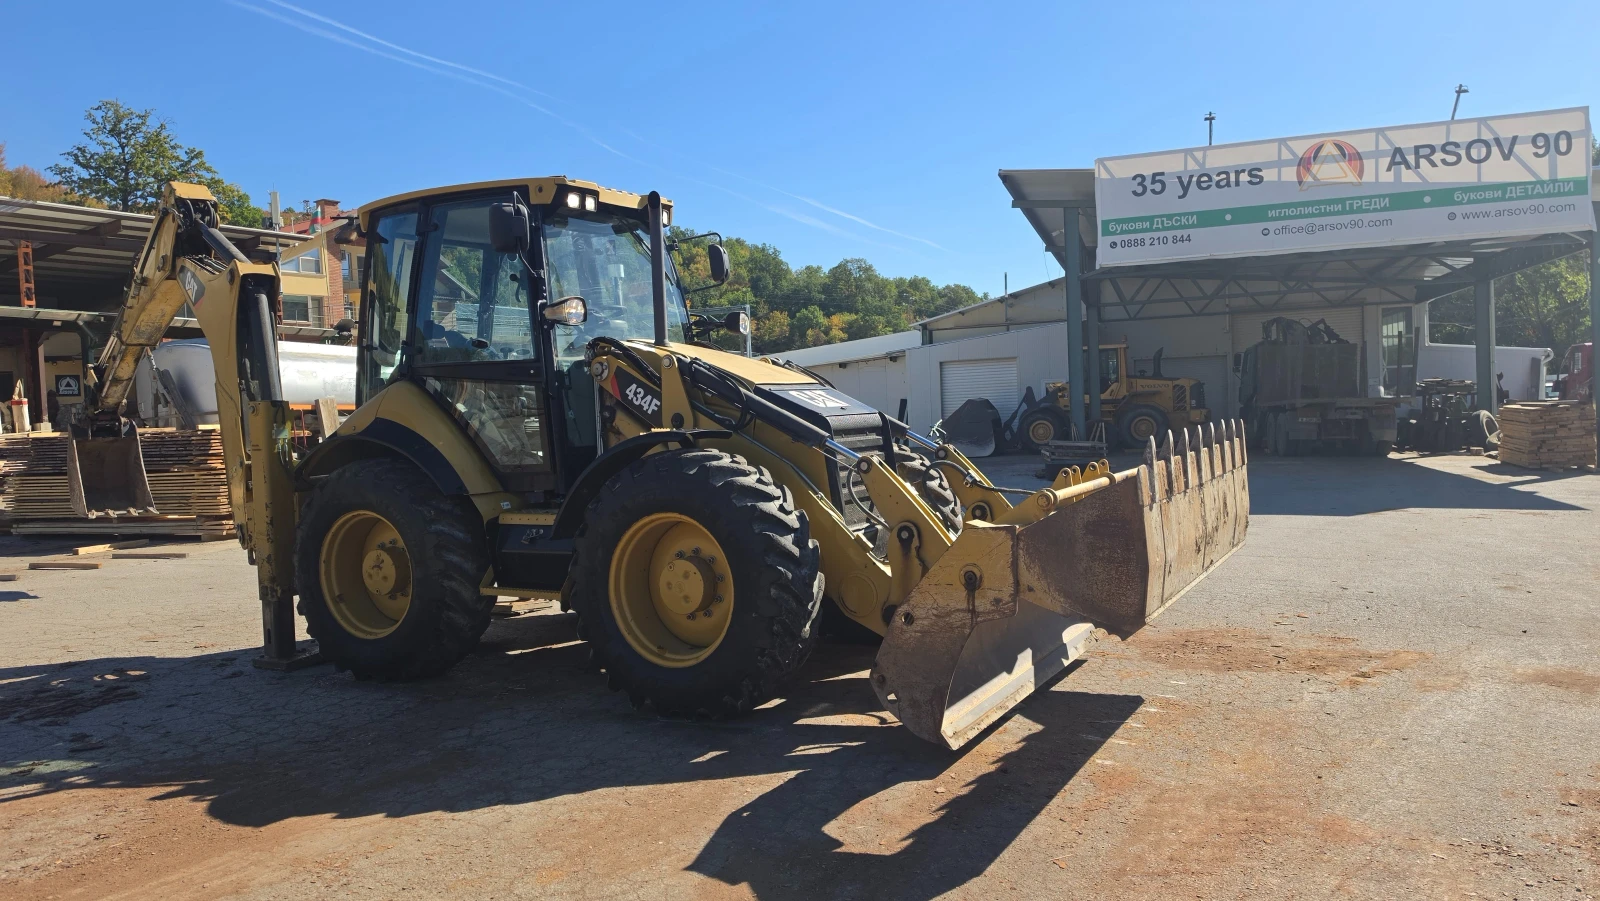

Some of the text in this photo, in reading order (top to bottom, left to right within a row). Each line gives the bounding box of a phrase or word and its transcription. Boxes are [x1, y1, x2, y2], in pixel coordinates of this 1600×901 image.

[1386, 130, 1573, 172] ARSOV 90
[1131, 167, 1264, 199] 35 years
[1453, 180, 1574, 203] букови ДЕТАЙЛИ
[1268, 197, 1390, 218] иглолистни ГРЕДИ
[1461, 202, 1576, 220] www.arsov90.com
[1108, 214, 1197, 233] букови ДЪСКИ
[1273, 218, 1393, 236] office@arsov90.com
[1120, 233, 1192, 249] 0888 210 844
[625, 383, 661, 415] 434F
[788, 390, 851, 408] CAT
